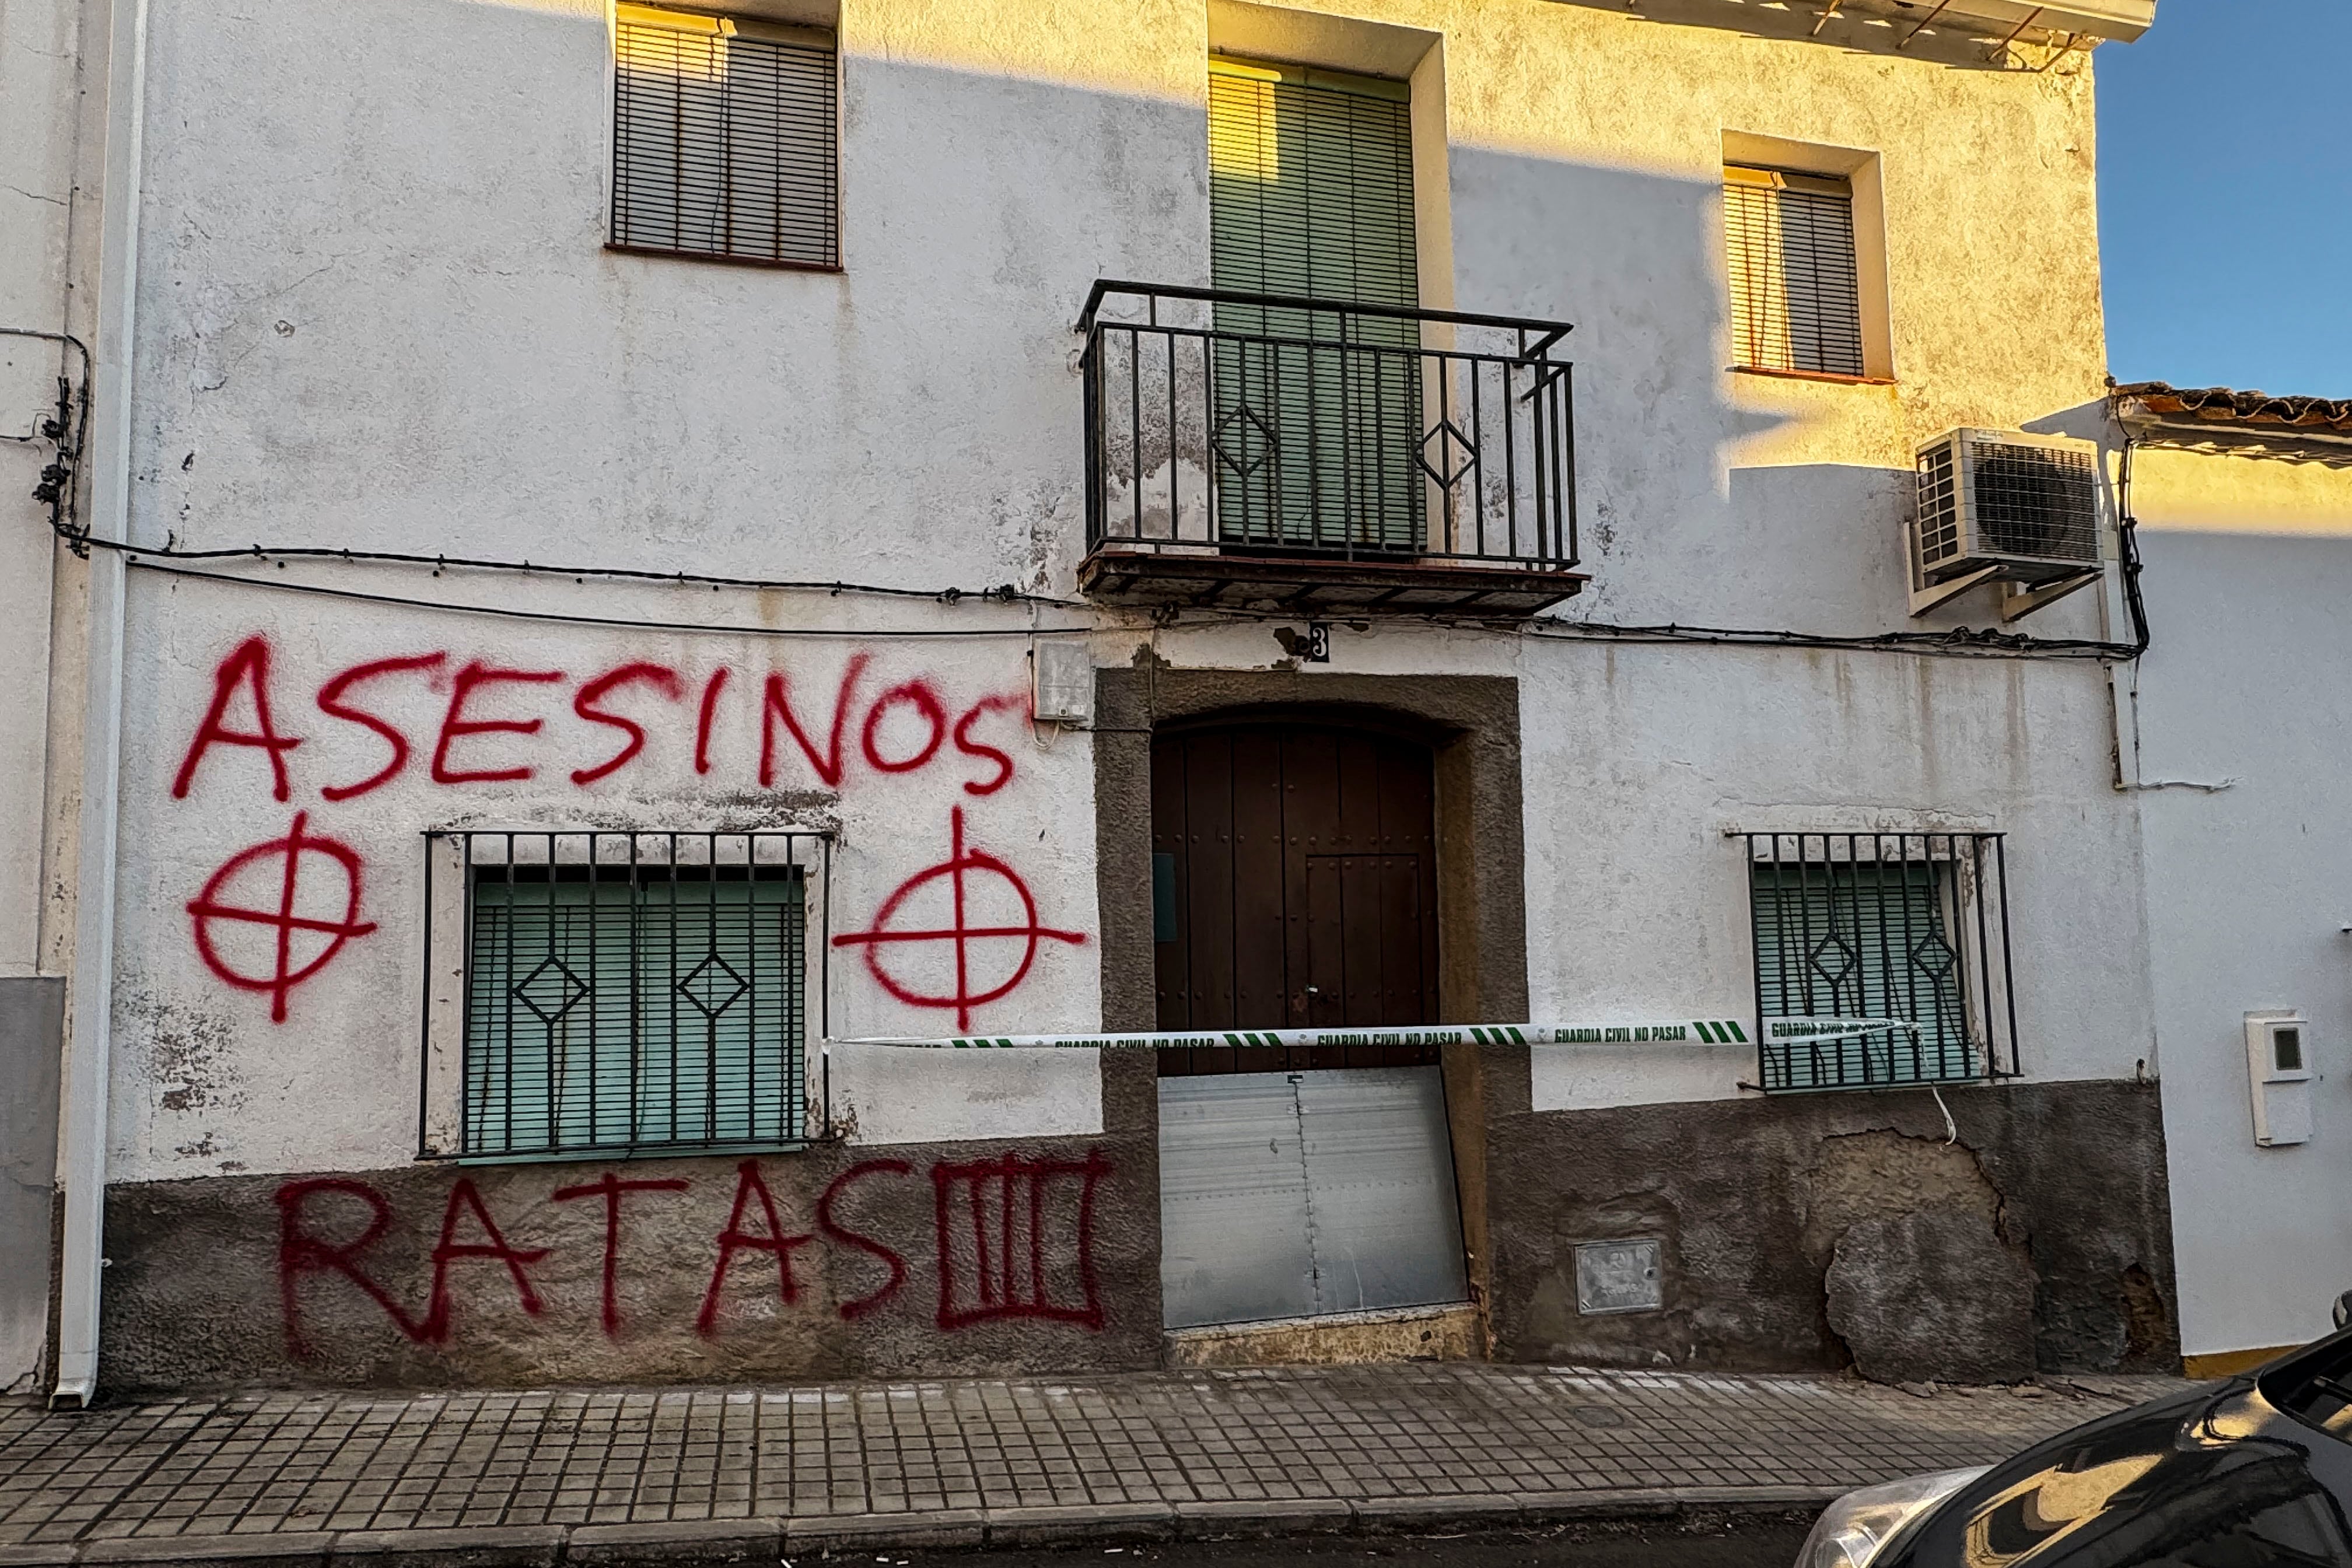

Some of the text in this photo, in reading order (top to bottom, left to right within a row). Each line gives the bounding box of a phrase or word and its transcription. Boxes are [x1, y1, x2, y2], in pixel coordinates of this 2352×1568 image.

[1312, 626, 1327, 657] 3
[173, 632, 1029, 803] ASESINOS
[1425, 1032, 1462, 1045] PASAR
[1555, 1026, 1686, 1042] GUARDIA CIVIL NO PASAR
[1772, 1023, 1817, 1037] GUARDIA
[275, 1158, 914, 1361] RATAS
